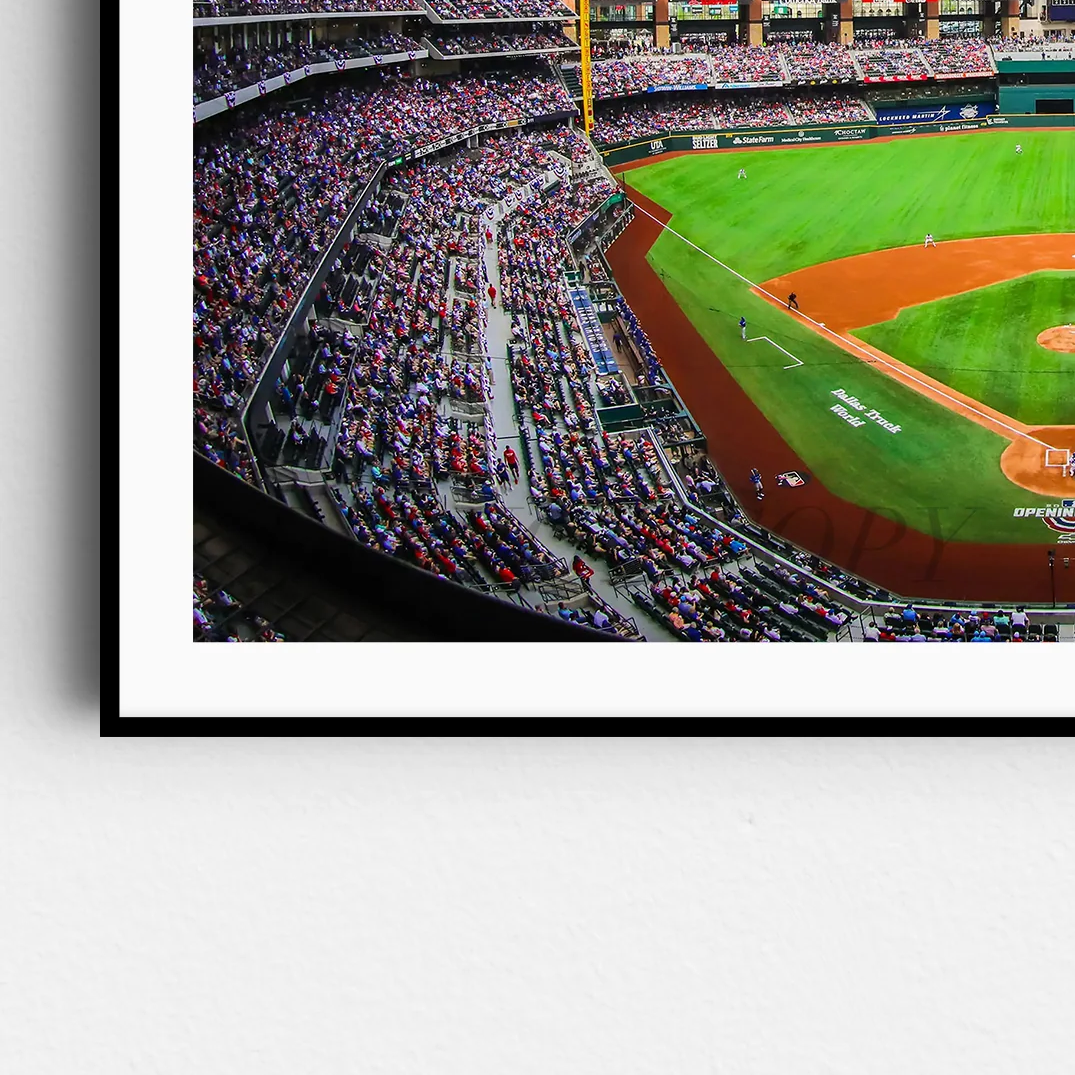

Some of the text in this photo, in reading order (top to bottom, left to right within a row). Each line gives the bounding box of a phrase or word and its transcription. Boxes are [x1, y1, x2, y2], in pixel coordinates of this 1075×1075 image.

[650, 140, 663, 150] UTA
[692, 138, 718, 150] SELTZER
[830, 404, 866, 428] World
[831, 388, 902, 434] Dallas Truck
